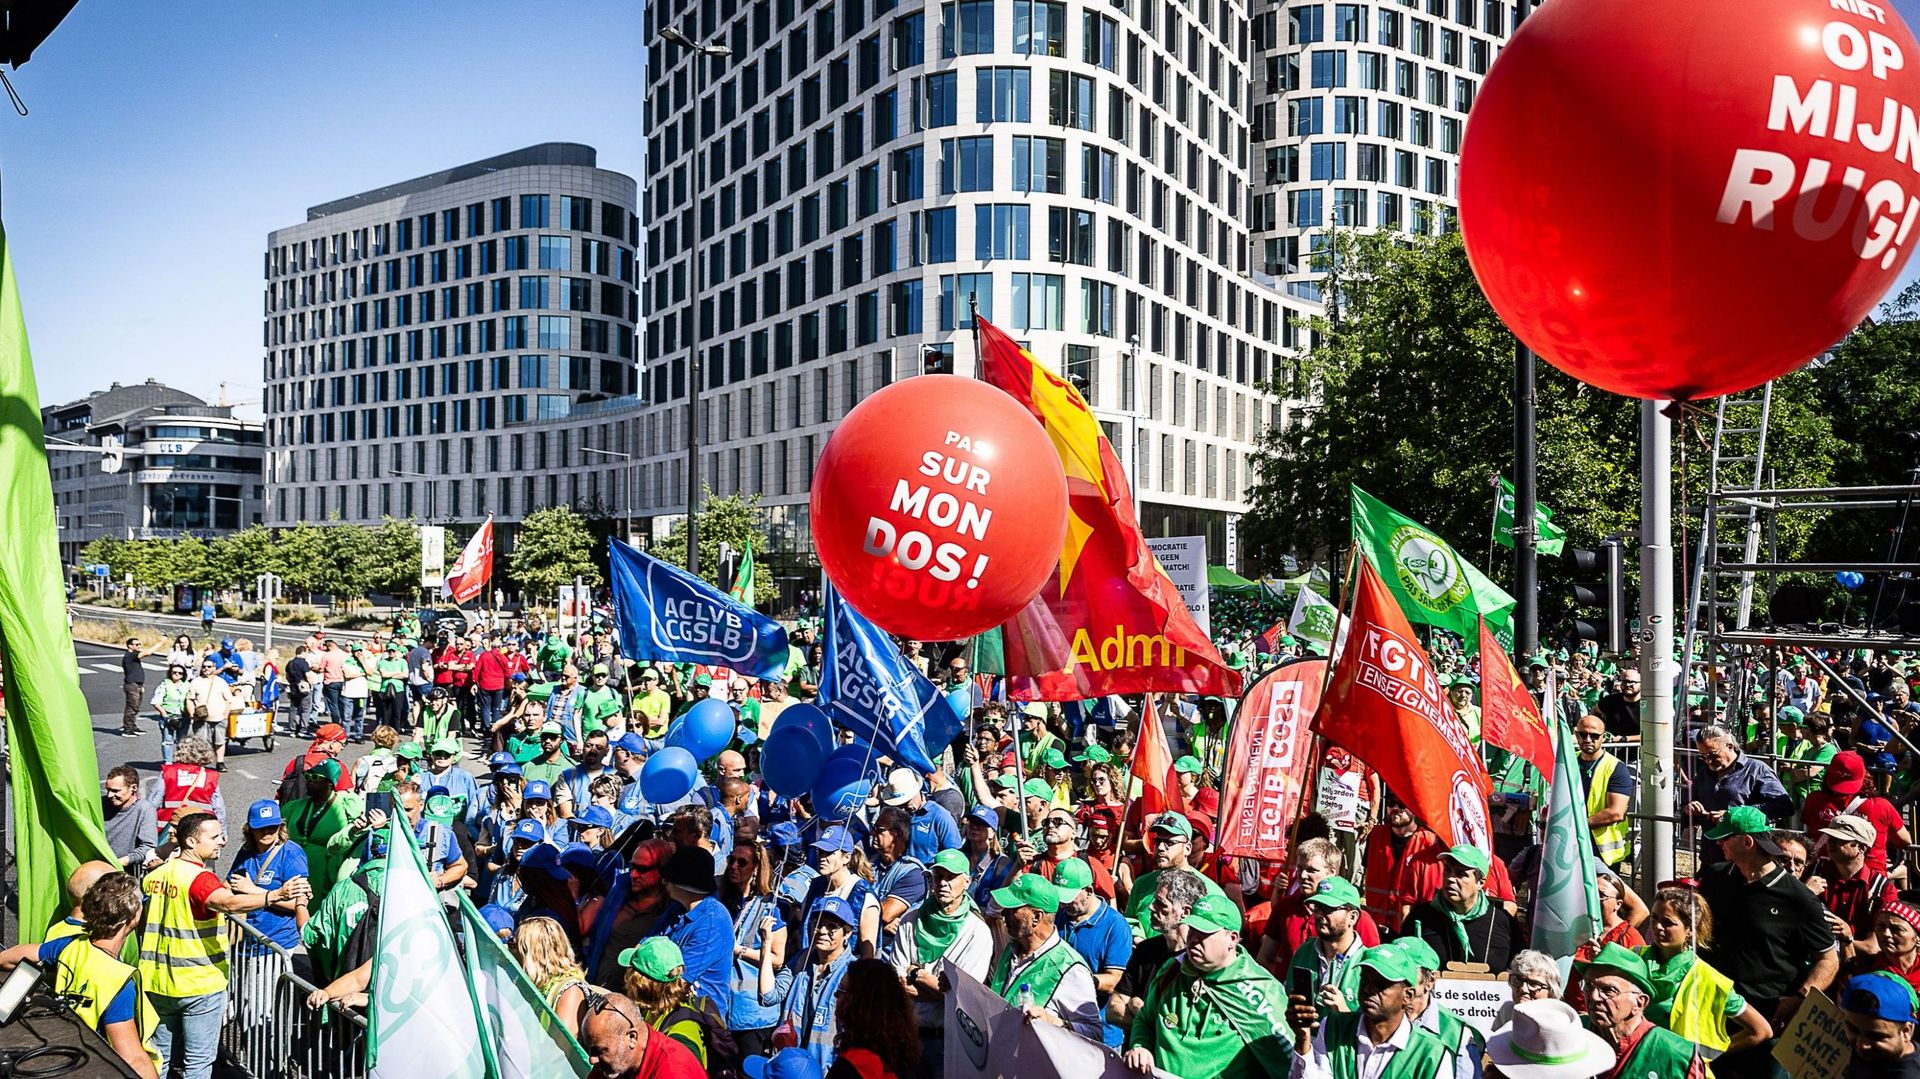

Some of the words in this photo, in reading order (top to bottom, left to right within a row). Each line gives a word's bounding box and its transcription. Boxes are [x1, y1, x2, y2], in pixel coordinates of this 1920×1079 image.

[1830, 0, 1886, 24] NIET
[1822, 21, 1904, 80] OP
[1767, 75, 1920, 173] MIJN
[1716, 149, 1920, 271] RUG!
[944, 431, 992, 457] PAS
[918, 451, 991, 495] SUR
[889, 479, 992, 541] MON
[1148, 543, 1188, 551] EMOCRATIE
[1401, 575, 1418, 595] PAS
[1418, 593, 1438, 610] SAN
[664, 597, 743, 629] ACLVB
[665, 619, 741, 650] CGSLB
[1368, 629, 1438, 702] FGTB
[1445, 989, 1459, 1000] de
[1462, 990, 1501, 1002] soldes
